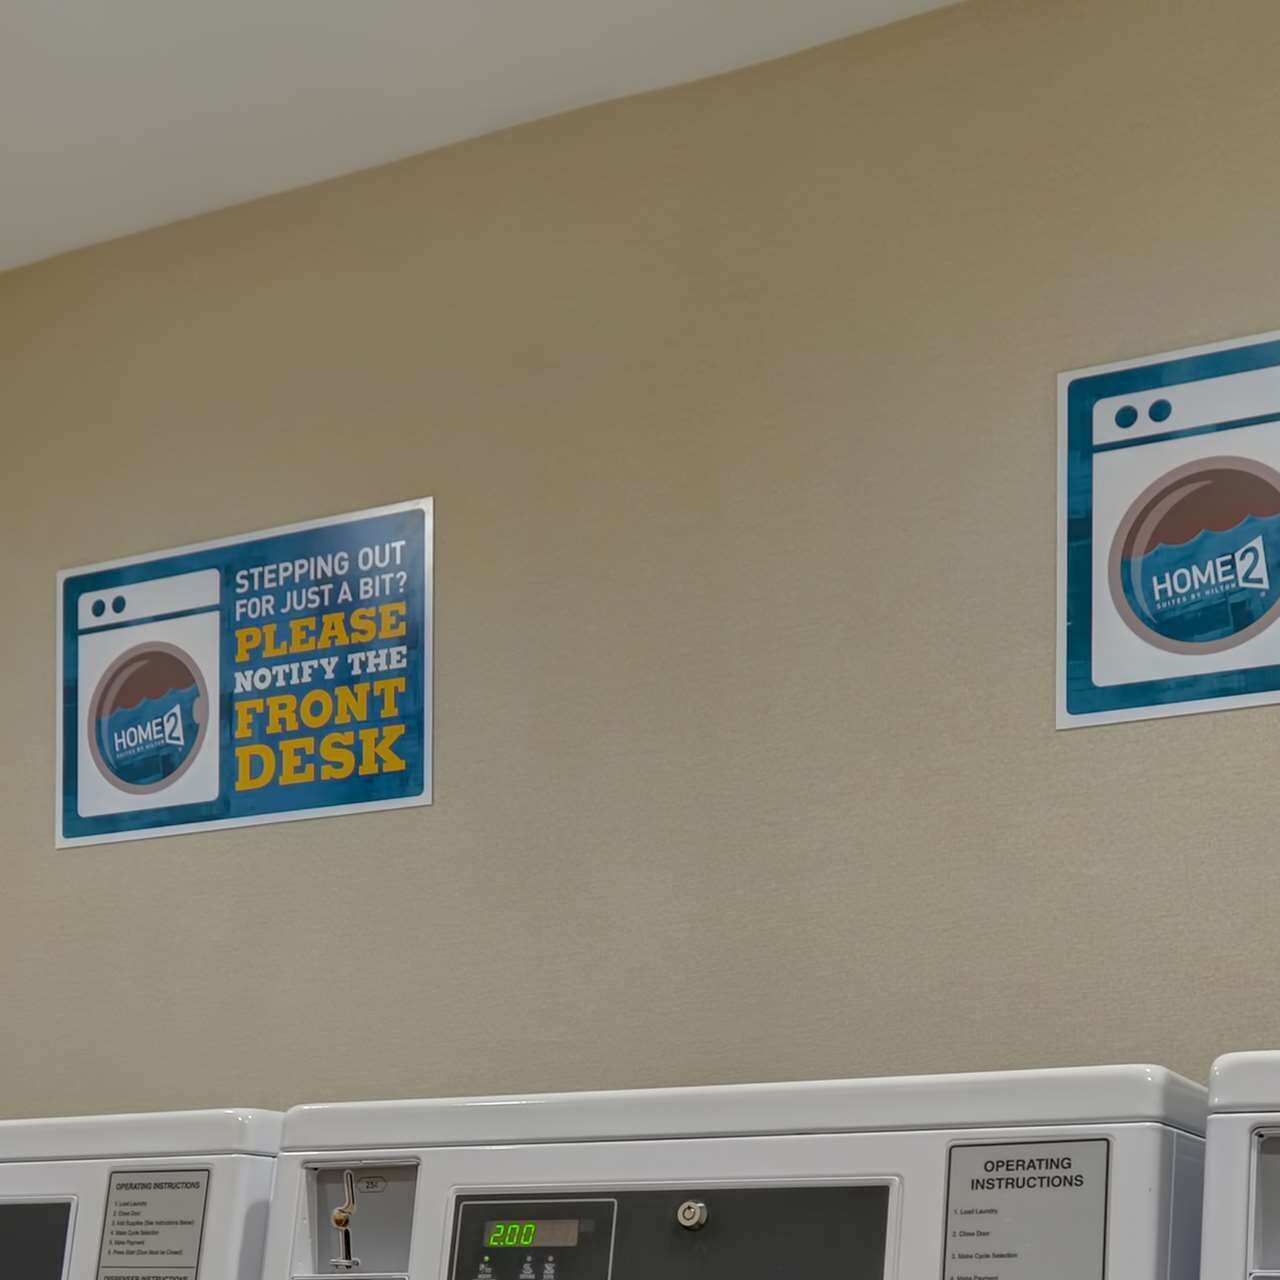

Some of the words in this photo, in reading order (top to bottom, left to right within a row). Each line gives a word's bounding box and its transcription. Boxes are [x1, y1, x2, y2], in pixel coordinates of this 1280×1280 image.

[236, 552, 349, 594] STEPPING
[358, 541, 405, 570] OUT
[236, 596, 274, 621] FOR
[280, 584, 332, 613] JUST
[338, 582, 352, 601] A
[359, 572, 406, 599] BIT?
[235, 602, 406, 662] PLEASE
[234, 657, 338, 693] NOTIFY
[347, 646, 406, 675] THE
[235, 677, 405, 739] FRONT
[235, 725, 405, 791] DESK
[115, 1182, 152, 1190] OPERATING
[971, 1175, 1084, 1190] INSTRUCTIONS
[984, 1158, 1072, 1172] OPERATING
[490, 1224, 536, 1245] 2.00
